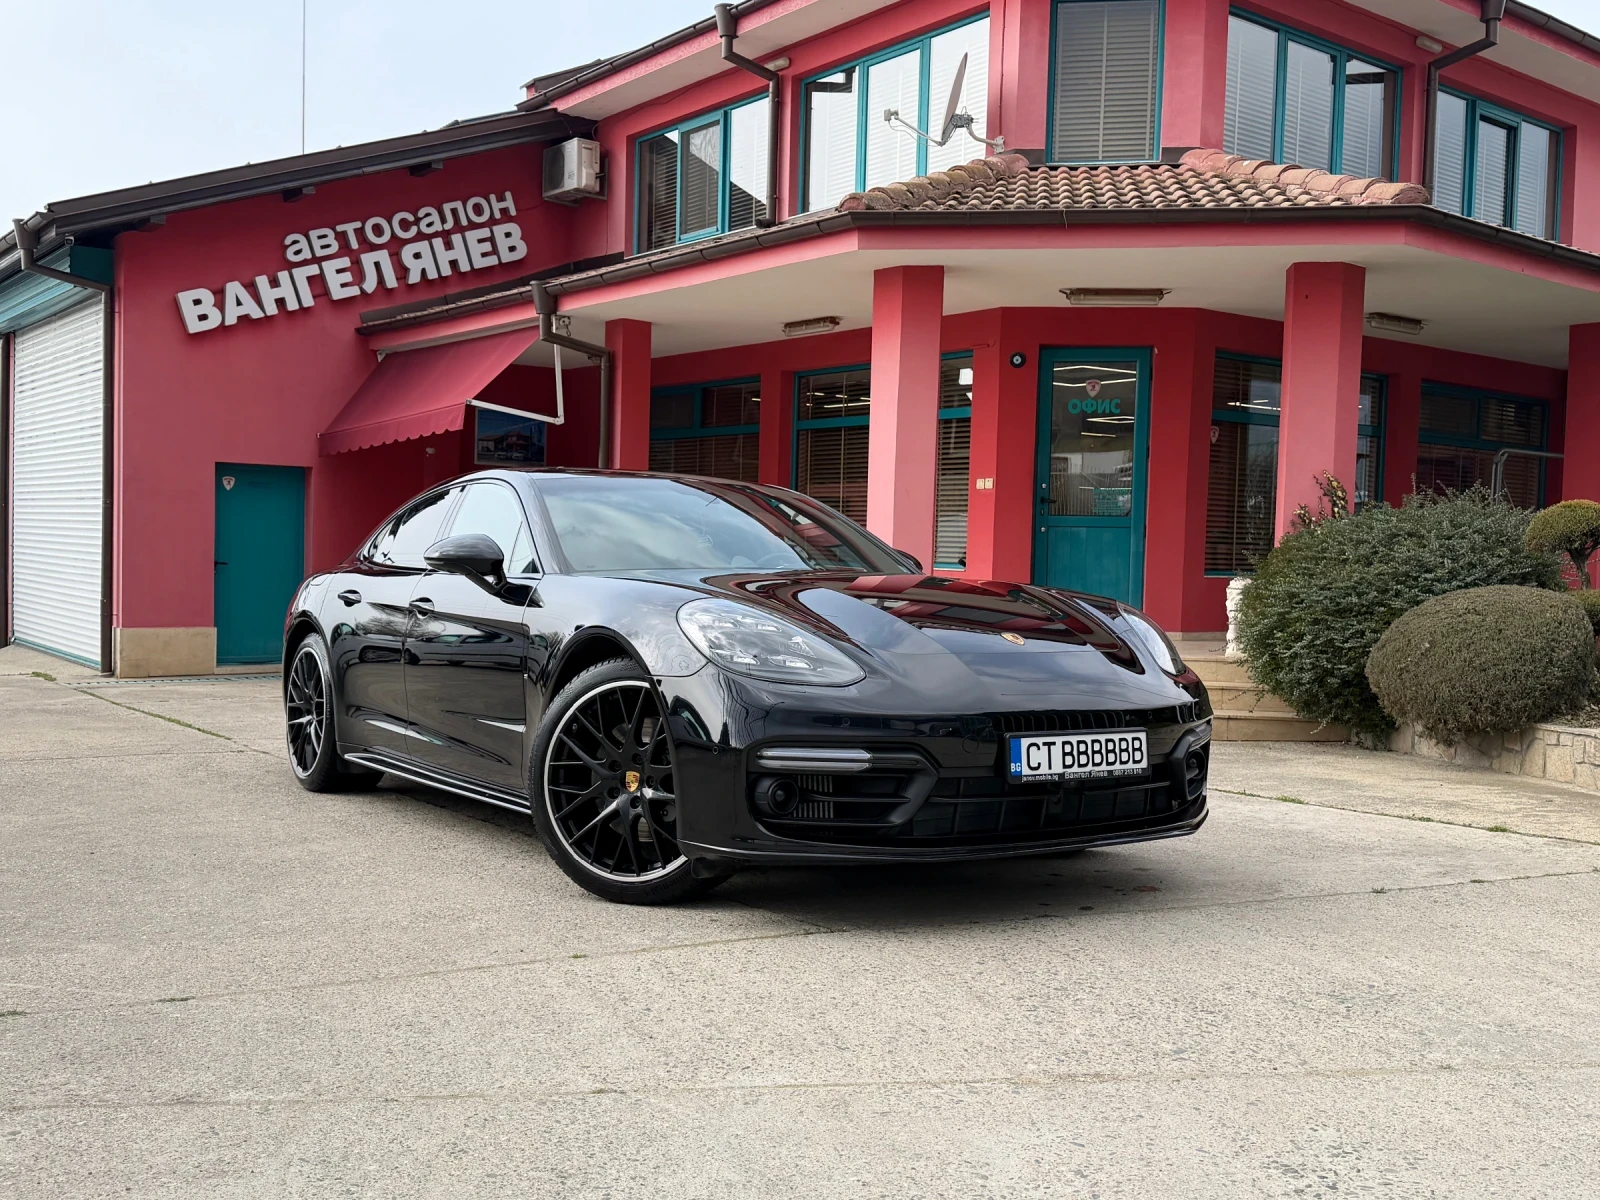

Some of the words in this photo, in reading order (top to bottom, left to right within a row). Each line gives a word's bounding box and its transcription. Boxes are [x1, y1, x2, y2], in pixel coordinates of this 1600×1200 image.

[283, 191, 517, 263] автосалон
[175, 249, 398, 334] ВАНГЕЛ
[400, 222, 528, 285] ЯНЕВ
[1068, 398, 1121, 414] ОФИС
[1011, 763, 1022, 772] BG
